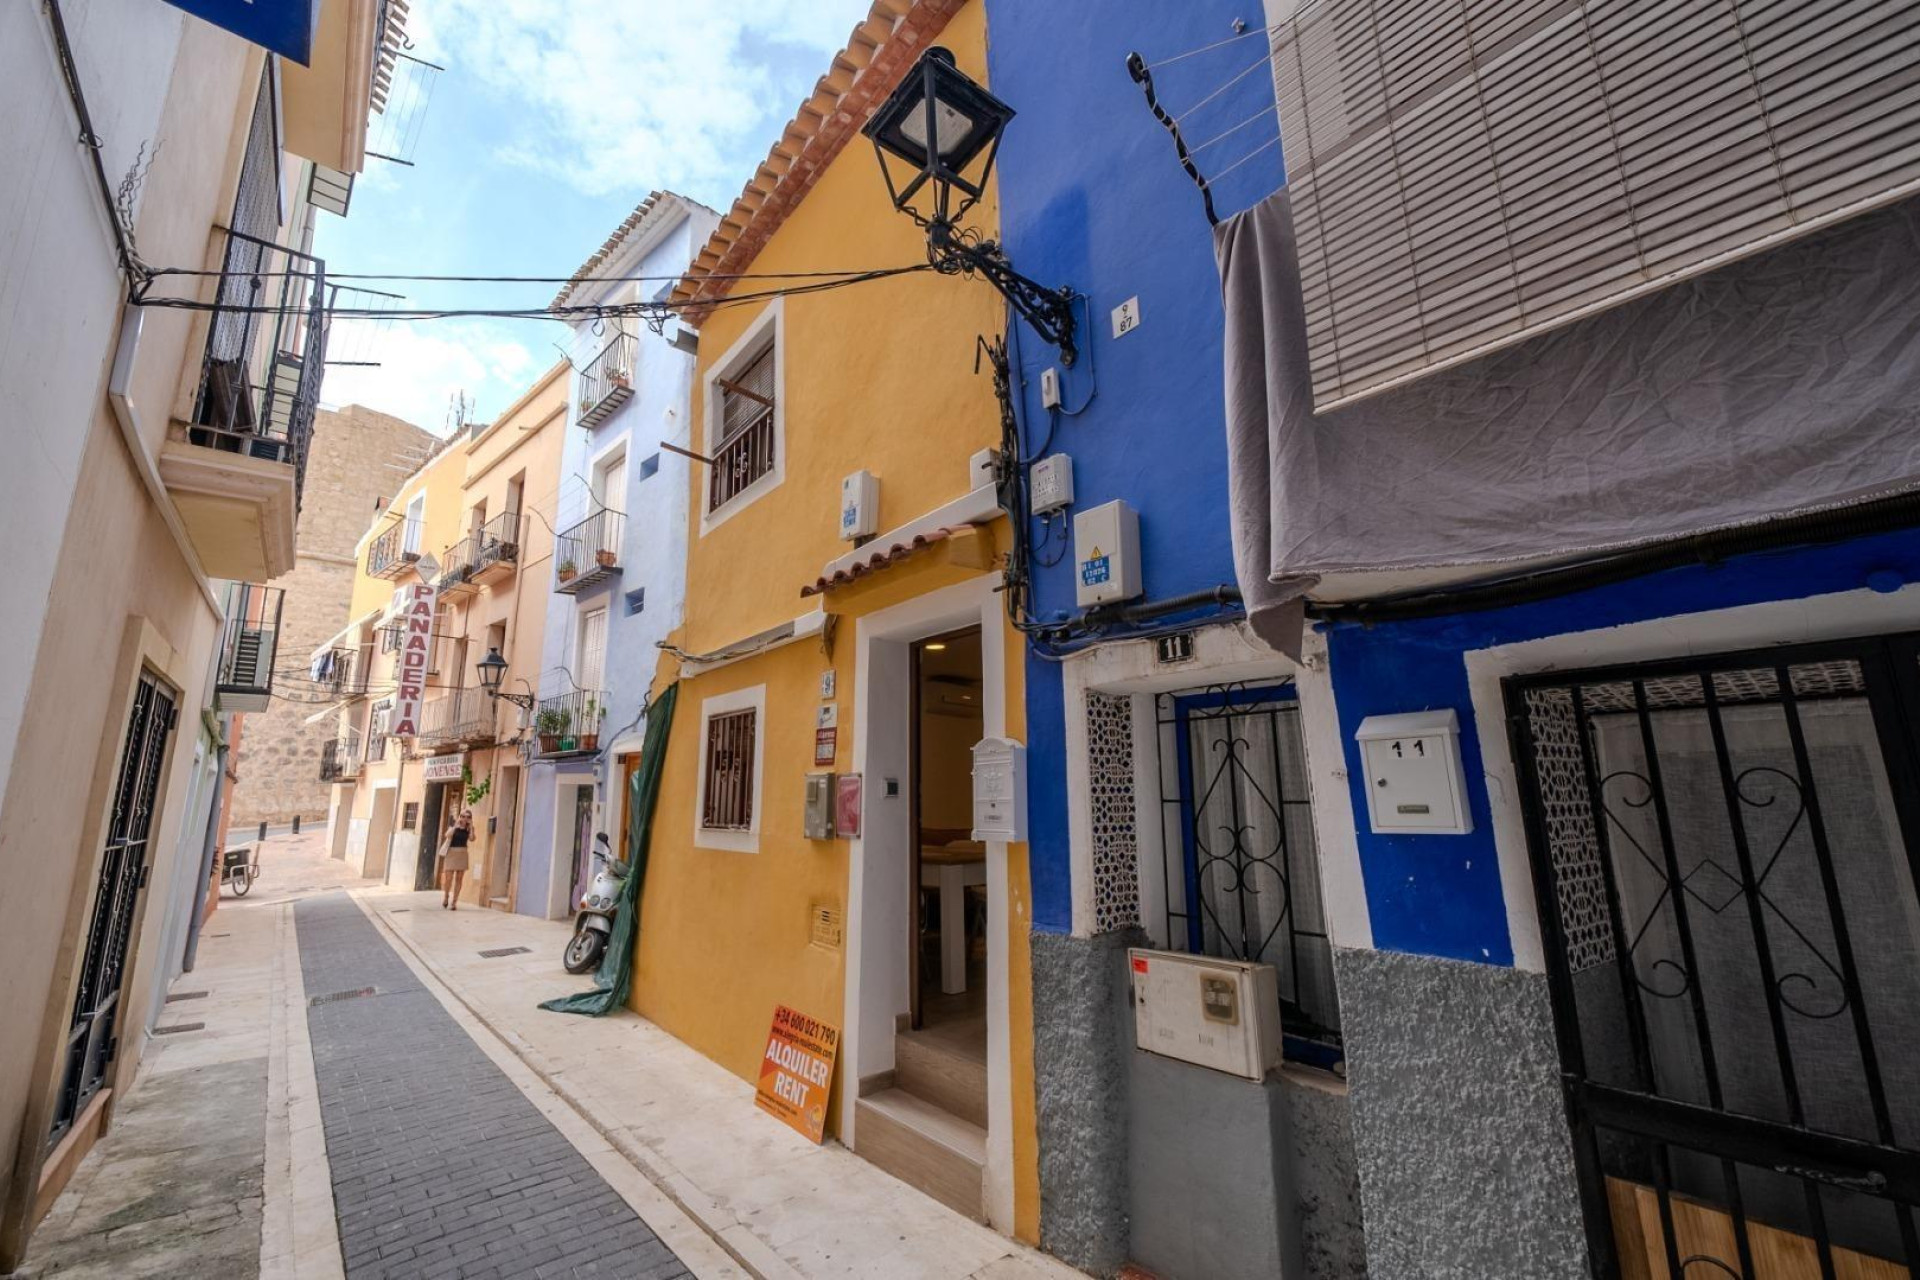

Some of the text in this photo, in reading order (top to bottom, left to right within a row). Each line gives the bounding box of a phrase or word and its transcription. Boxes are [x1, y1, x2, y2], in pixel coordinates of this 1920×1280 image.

[1120, 316, 1132, 332] 87
[1122, 304, 1128, 315] 9
[395, 586, 434, 734] PANADERIA
[1165, 636, 1182, 658] 11
[766, 1039, 829, 1089] ALQUILER
[774, 1071, 810, 1109] RENT
